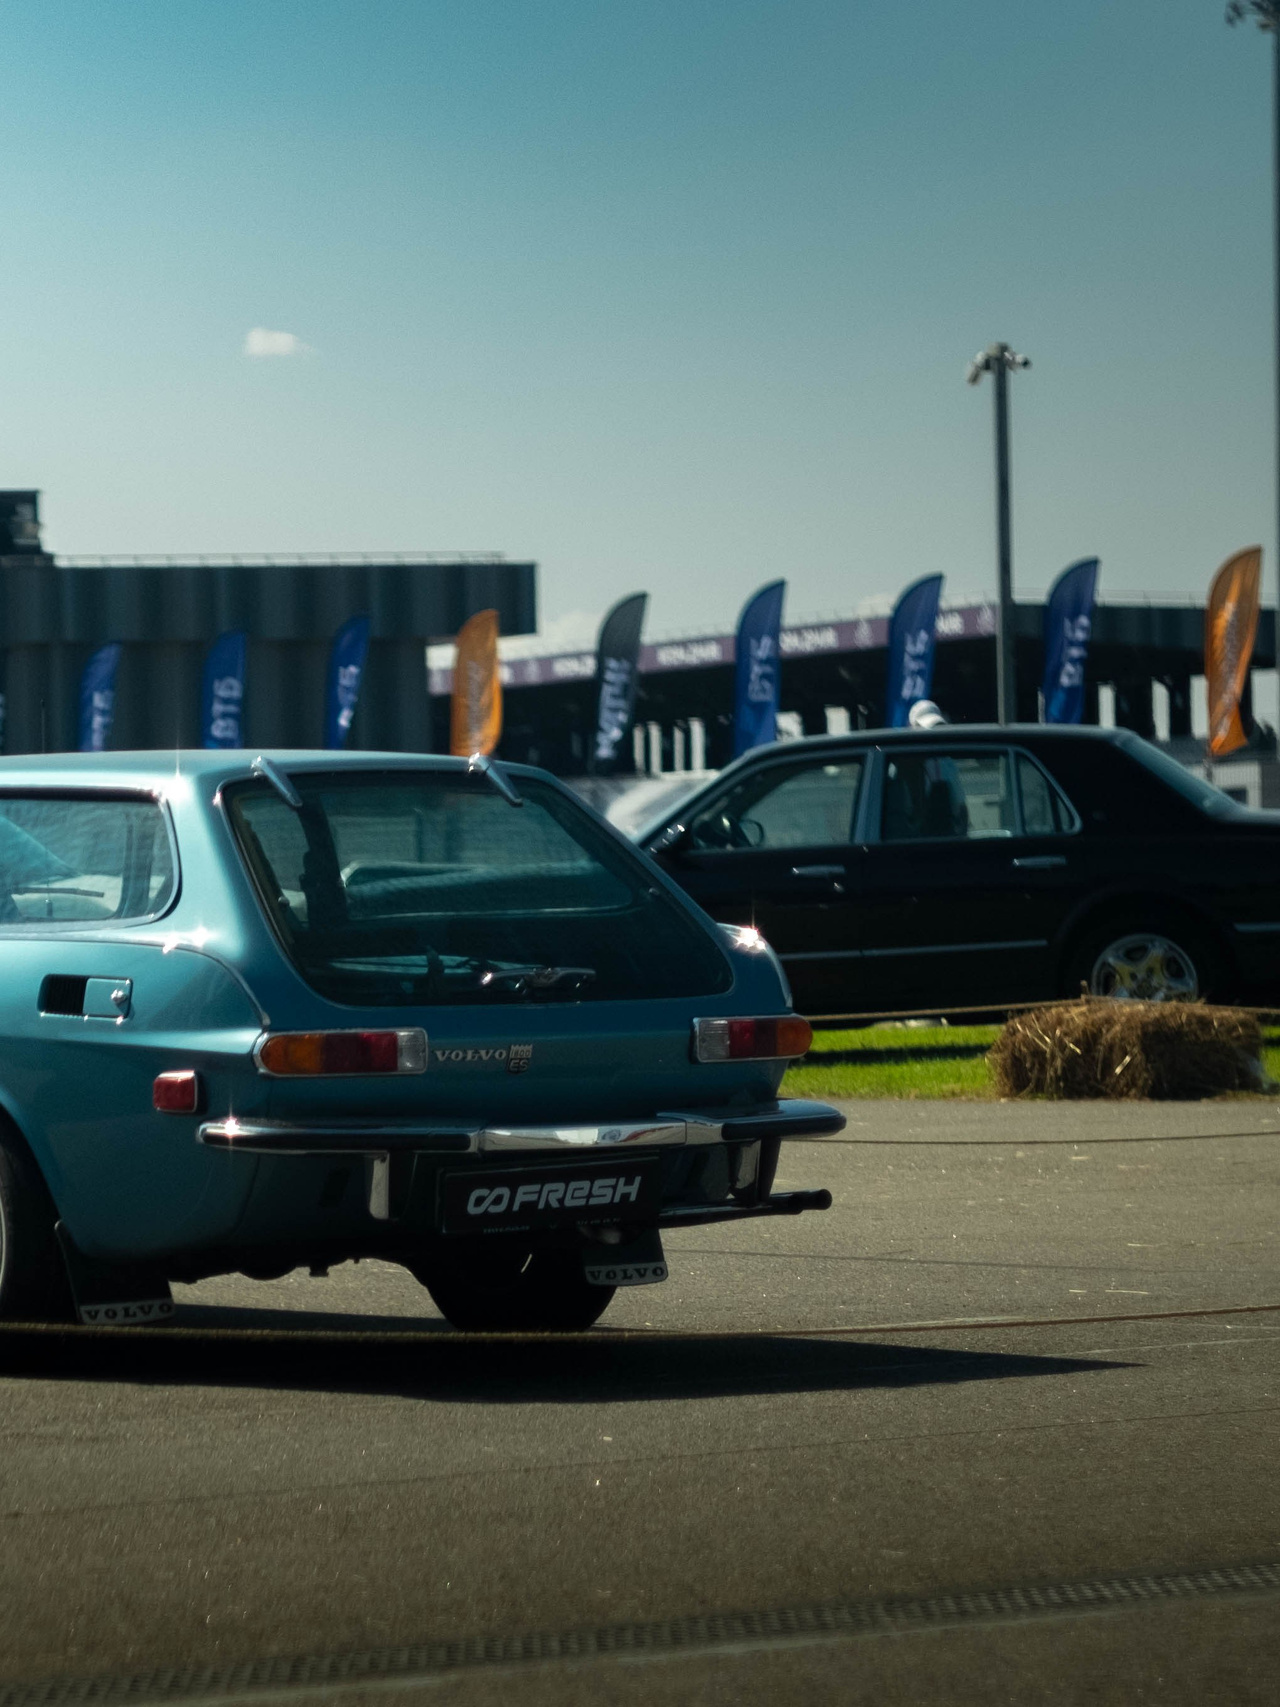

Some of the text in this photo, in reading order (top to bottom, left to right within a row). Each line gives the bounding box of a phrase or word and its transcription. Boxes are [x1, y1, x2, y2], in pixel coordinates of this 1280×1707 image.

[211, 676, 244, 739] ВТБ
[434, 1048, 507, 1062] VOLVO
[509, 1059, 529, 1071] ES
[587, 1266, 665, 1280] VOLVO
[84, 1302, 173, 1321] VOLVO
